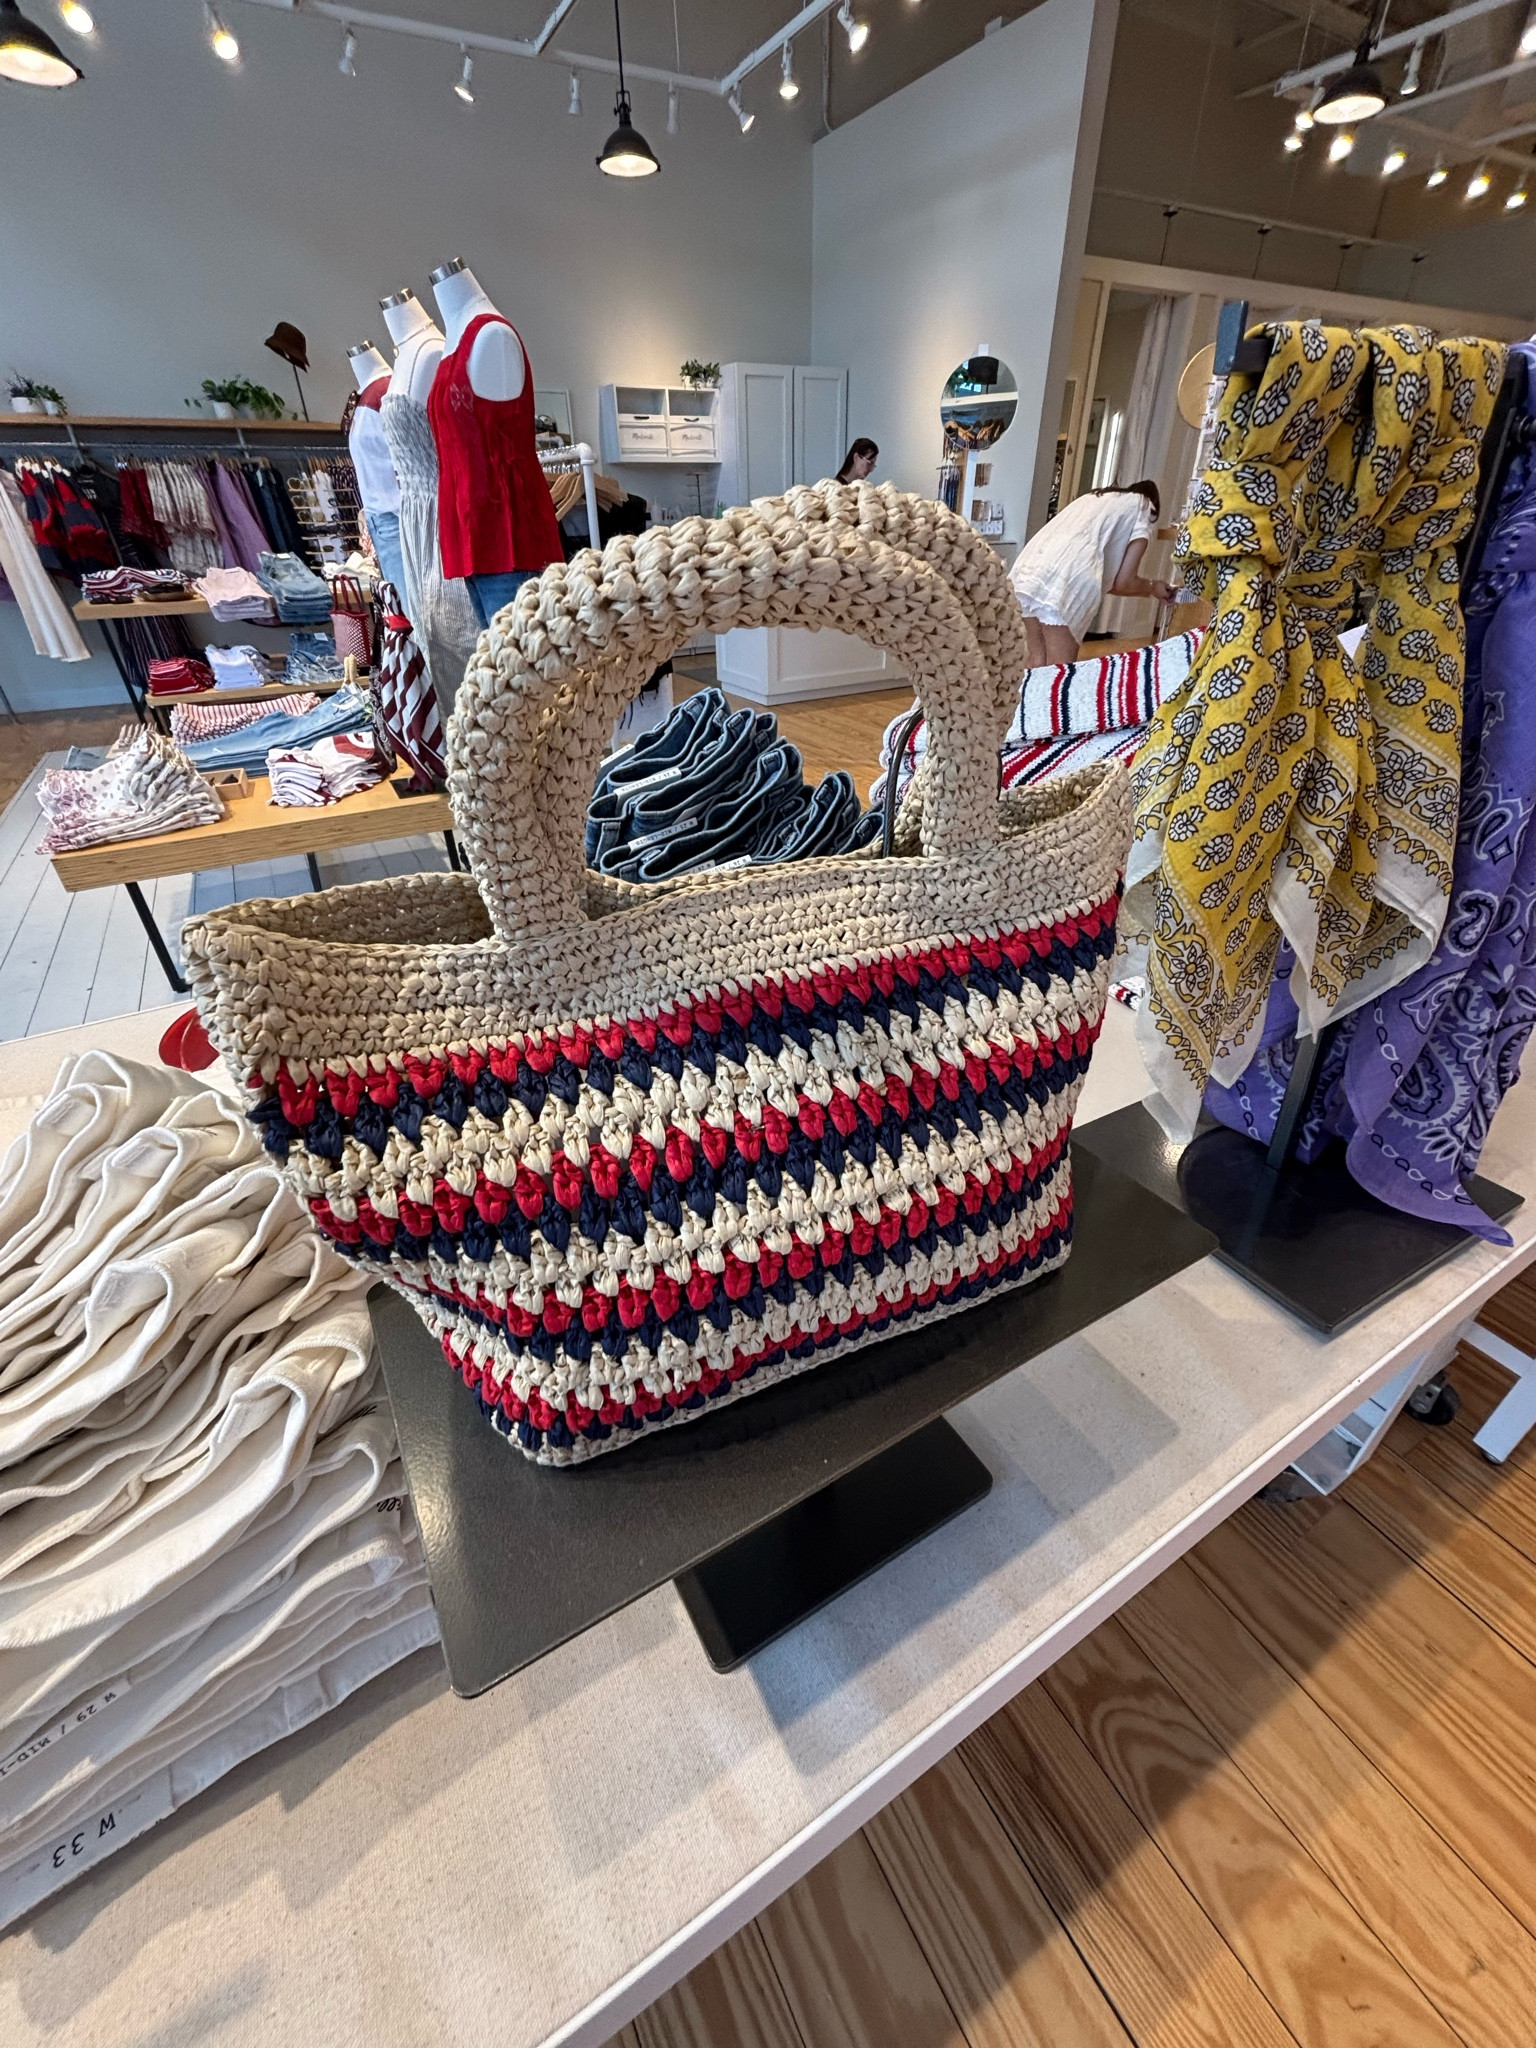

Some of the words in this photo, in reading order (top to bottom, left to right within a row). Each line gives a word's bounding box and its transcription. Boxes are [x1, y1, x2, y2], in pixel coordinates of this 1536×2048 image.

[635, 829, 673, 846] MID-LENGTH
[104, 1692, 117, 1703] W
[76, 1704, 98, 1723] 29
[60, 1724, 66, 1735] /
[97, 1812, 117, 1839] W
[52, 1832, 85, 1869] 33
